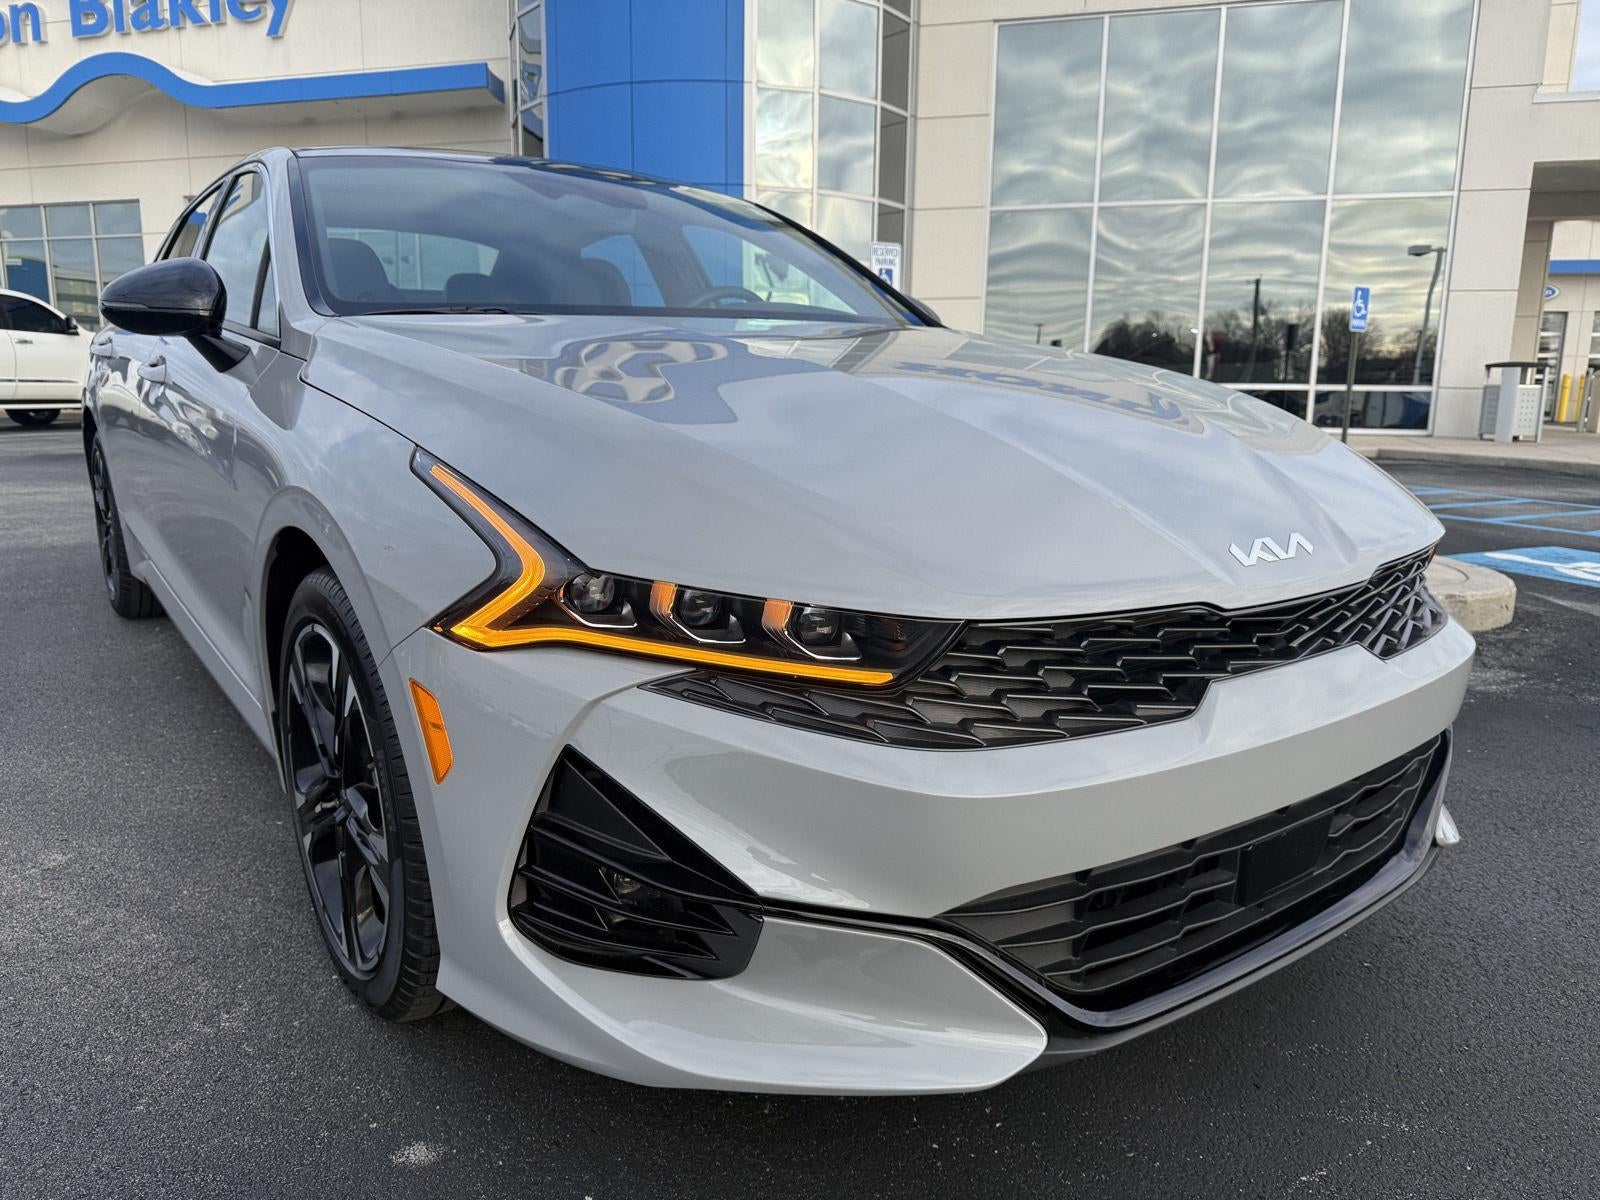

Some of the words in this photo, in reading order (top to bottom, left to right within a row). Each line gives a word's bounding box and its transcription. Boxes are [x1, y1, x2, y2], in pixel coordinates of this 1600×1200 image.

[0, 2, 46, 46] n
[873, 247, 898, 257] RESERVED
[875, 258, 897, 267] PARKING
[1228, 532, 1314, 567] KIA
